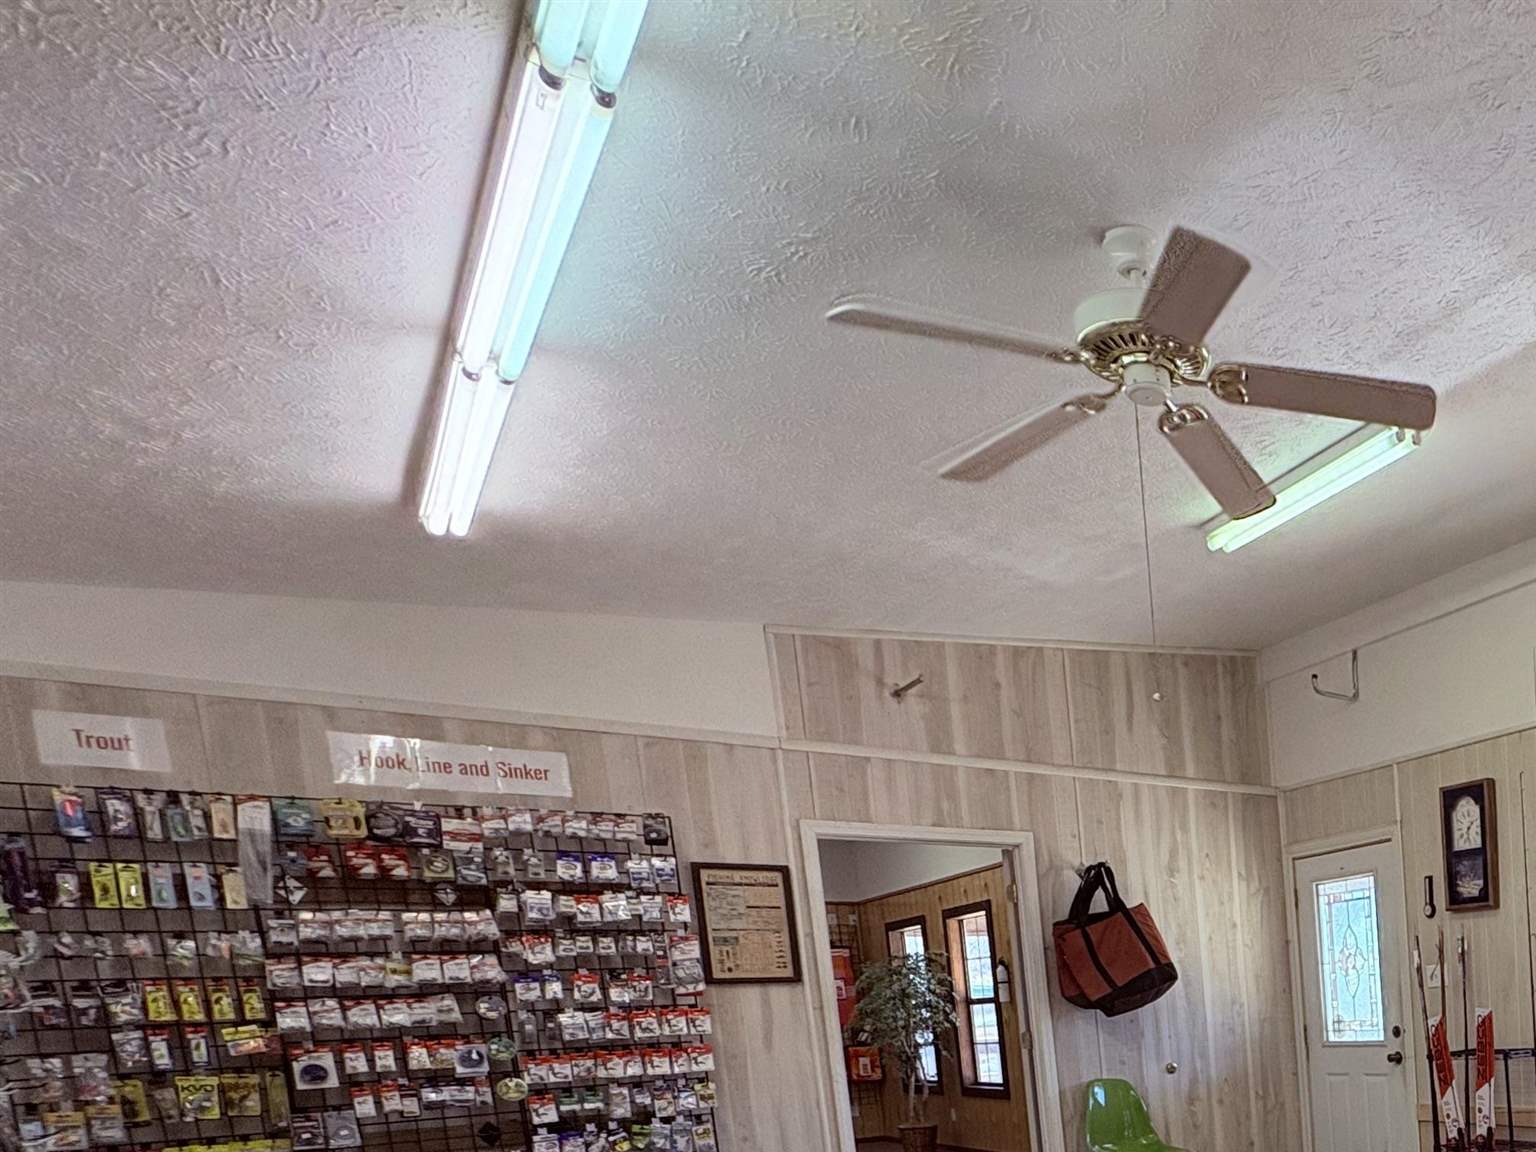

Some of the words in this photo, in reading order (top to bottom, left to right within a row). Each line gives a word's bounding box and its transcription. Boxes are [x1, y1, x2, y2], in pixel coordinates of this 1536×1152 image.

[71, 728, 134, 752] Trout
[416, 755, 453, 775] Line
[458, 761, 490, 777] and
[496, 761, 550, 781] Sinker
